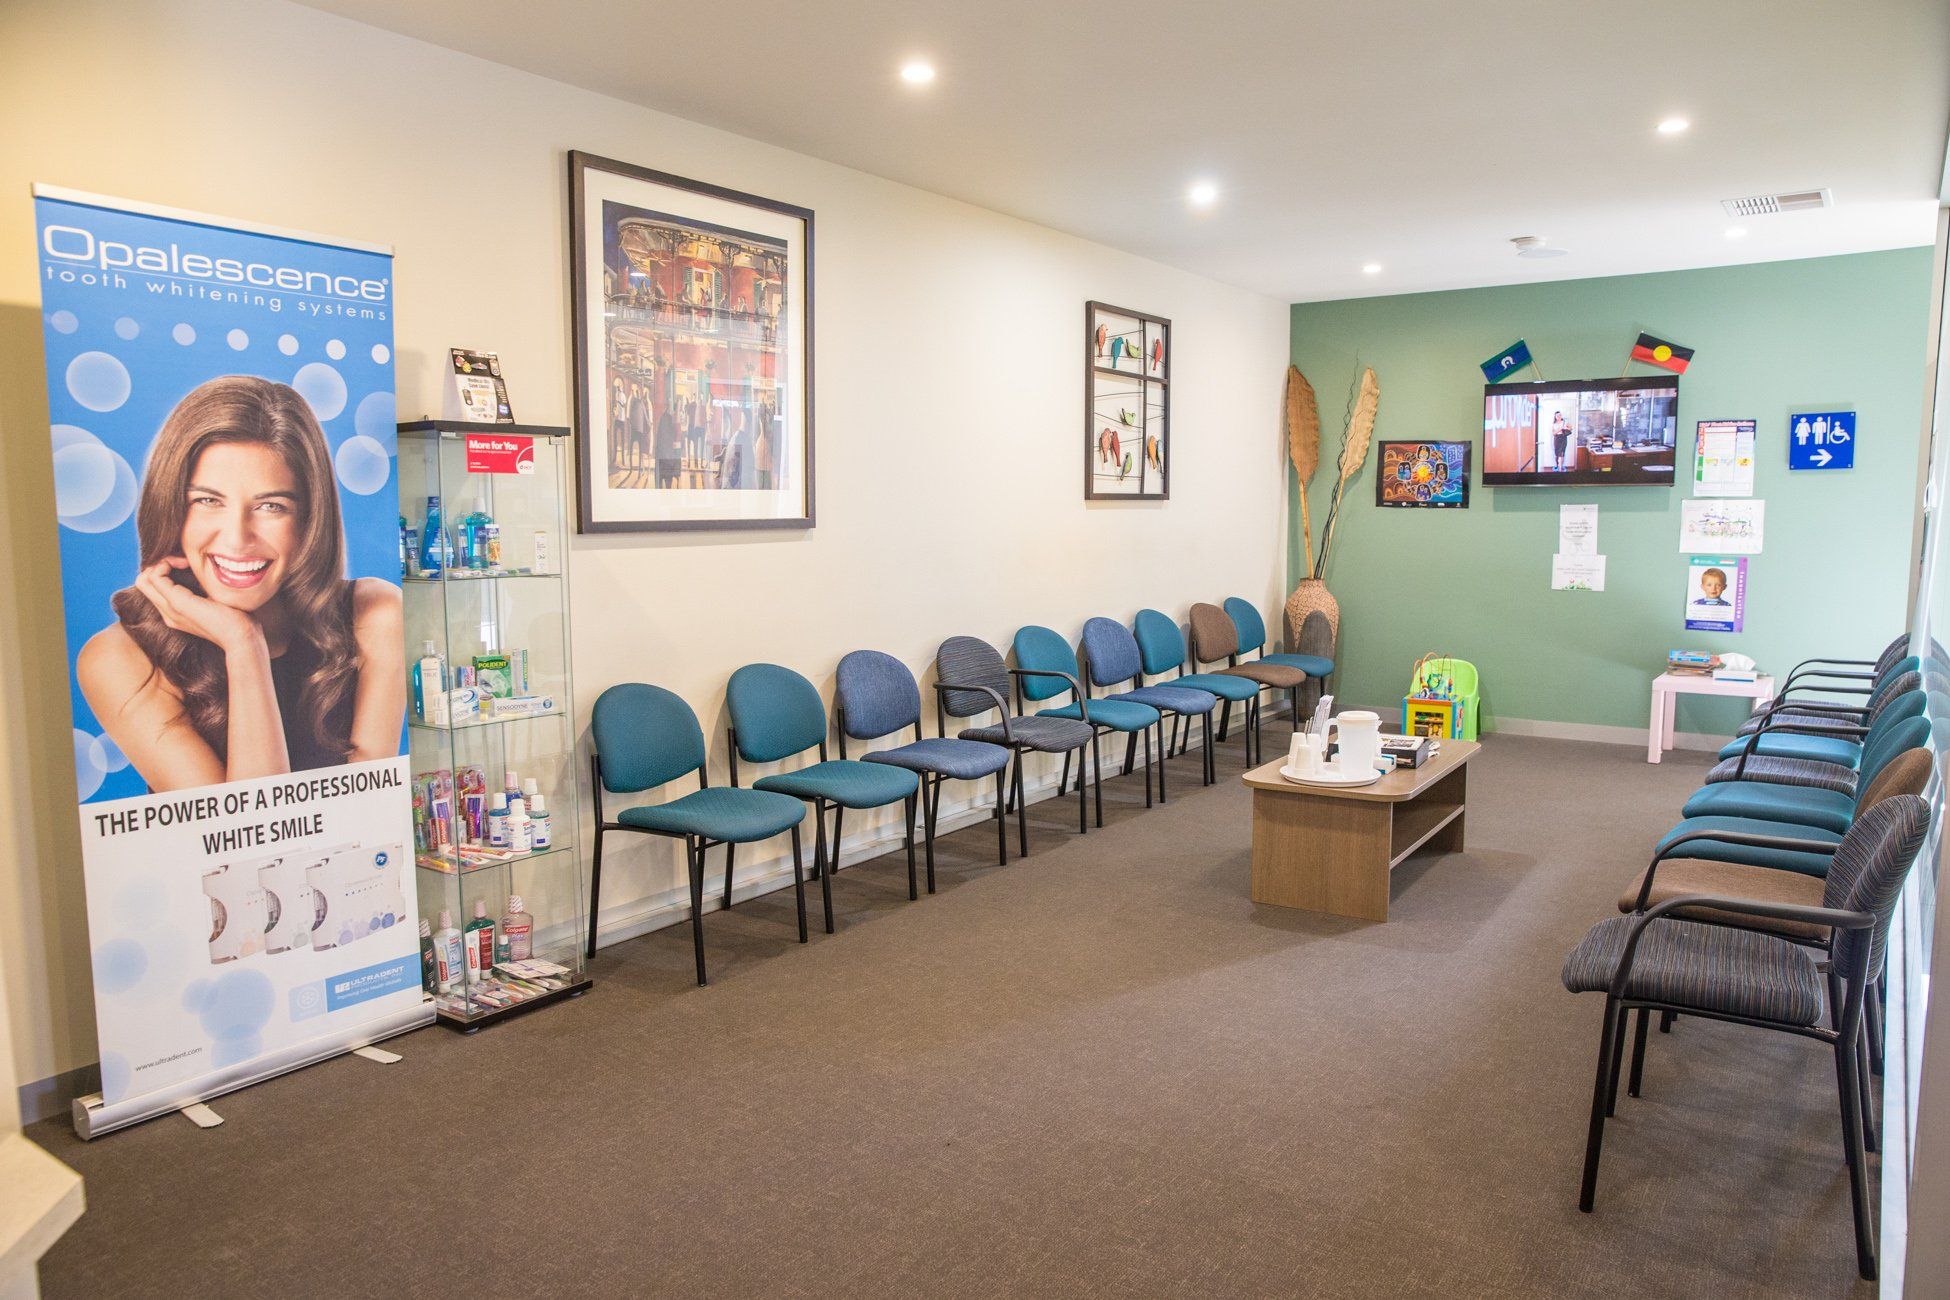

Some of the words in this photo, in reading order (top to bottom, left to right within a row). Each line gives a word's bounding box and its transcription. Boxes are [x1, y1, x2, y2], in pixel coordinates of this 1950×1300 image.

[47, 265, 128, 290] tooth
[146, 281, 283, 312] whitening
[297, 300, 387, 321] systems
[469, 440, 491, 449] More
[491, 441, 503, 450] for
[503, 442, 518, 450] You
[477, 660, 507, 669] POLIDENT
[496, 703, 528, 712] SENSODYNE
[95, 809, 139, 837] THE
[145, 796, 220, 829] POWER
[224, 791, 250, 815] OF
[255, 789, 268, 810] A
[272, 767, 402, 806] PROFESSIONAL
[203, 824, 266, 855] WHITE
[270, 813, 324, 843] SMILE
[350, 965, 405, 986] ULTRADENT
[135, 1047, 203, 1072] www.ultradent.com
